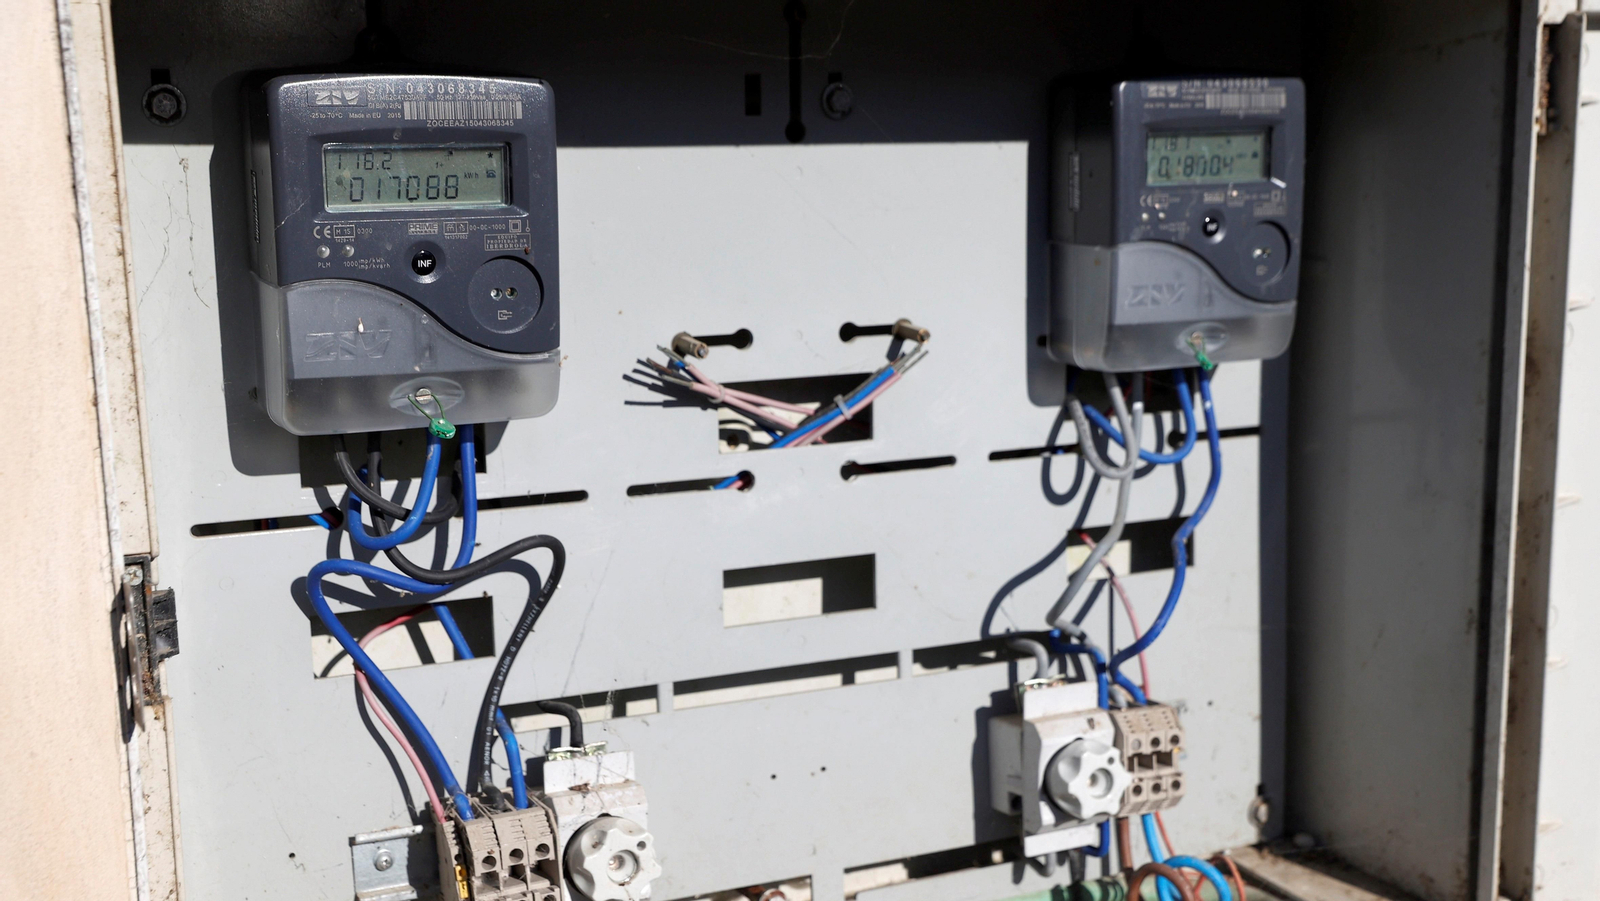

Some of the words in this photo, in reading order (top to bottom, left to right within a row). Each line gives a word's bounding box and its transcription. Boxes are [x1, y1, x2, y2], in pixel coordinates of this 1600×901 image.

[406, 82, 496, 94] 043068345
[350, 174, 459, 202] 017088
[409, 223, 438, 231] PRIME
[343, 260, 359, 268] 1000
[417, 259, 432, 269] INF
